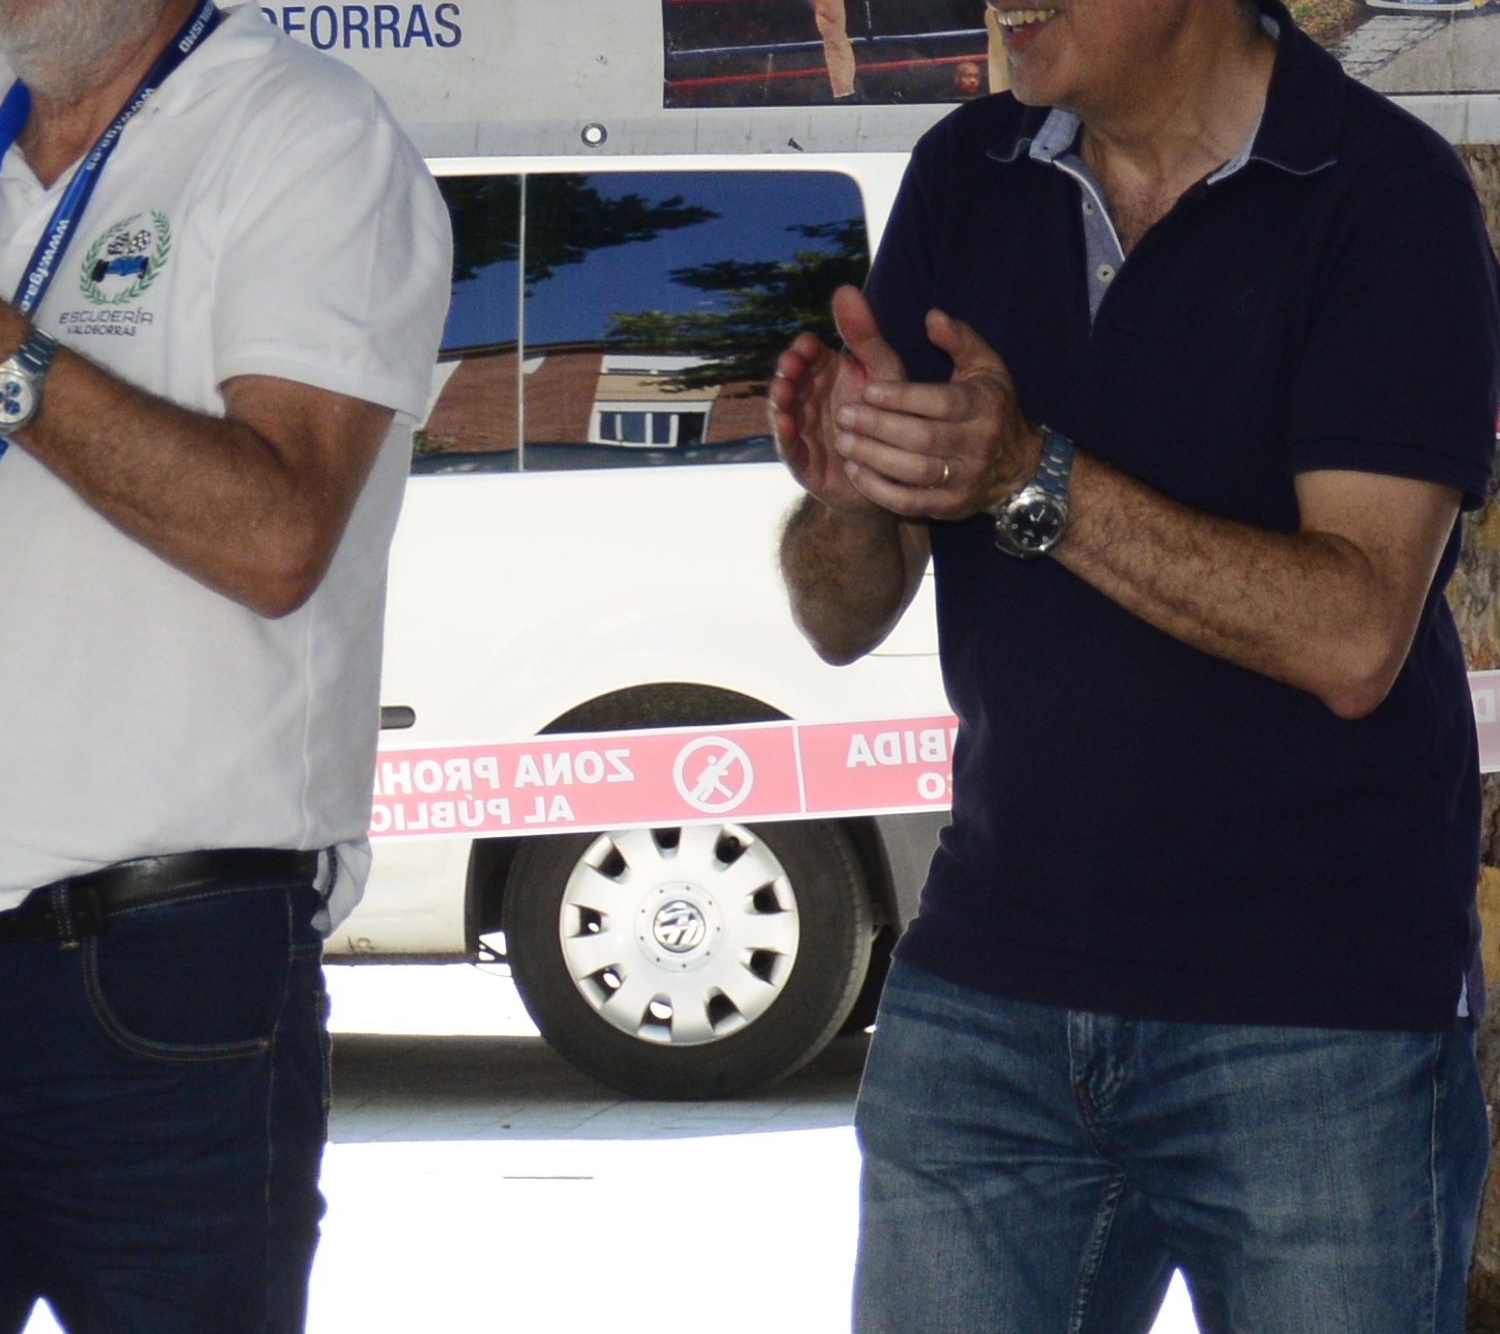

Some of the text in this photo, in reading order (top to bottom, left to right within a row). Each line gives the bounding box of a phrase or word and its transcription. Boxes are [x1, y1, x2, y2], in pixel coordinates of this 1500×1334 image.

[20, 219, 71, 314] www.fga.e
[59, 306, 154, 325] ESCUDERÍA
[67, 323, 137, 338] VALDEORRAS
